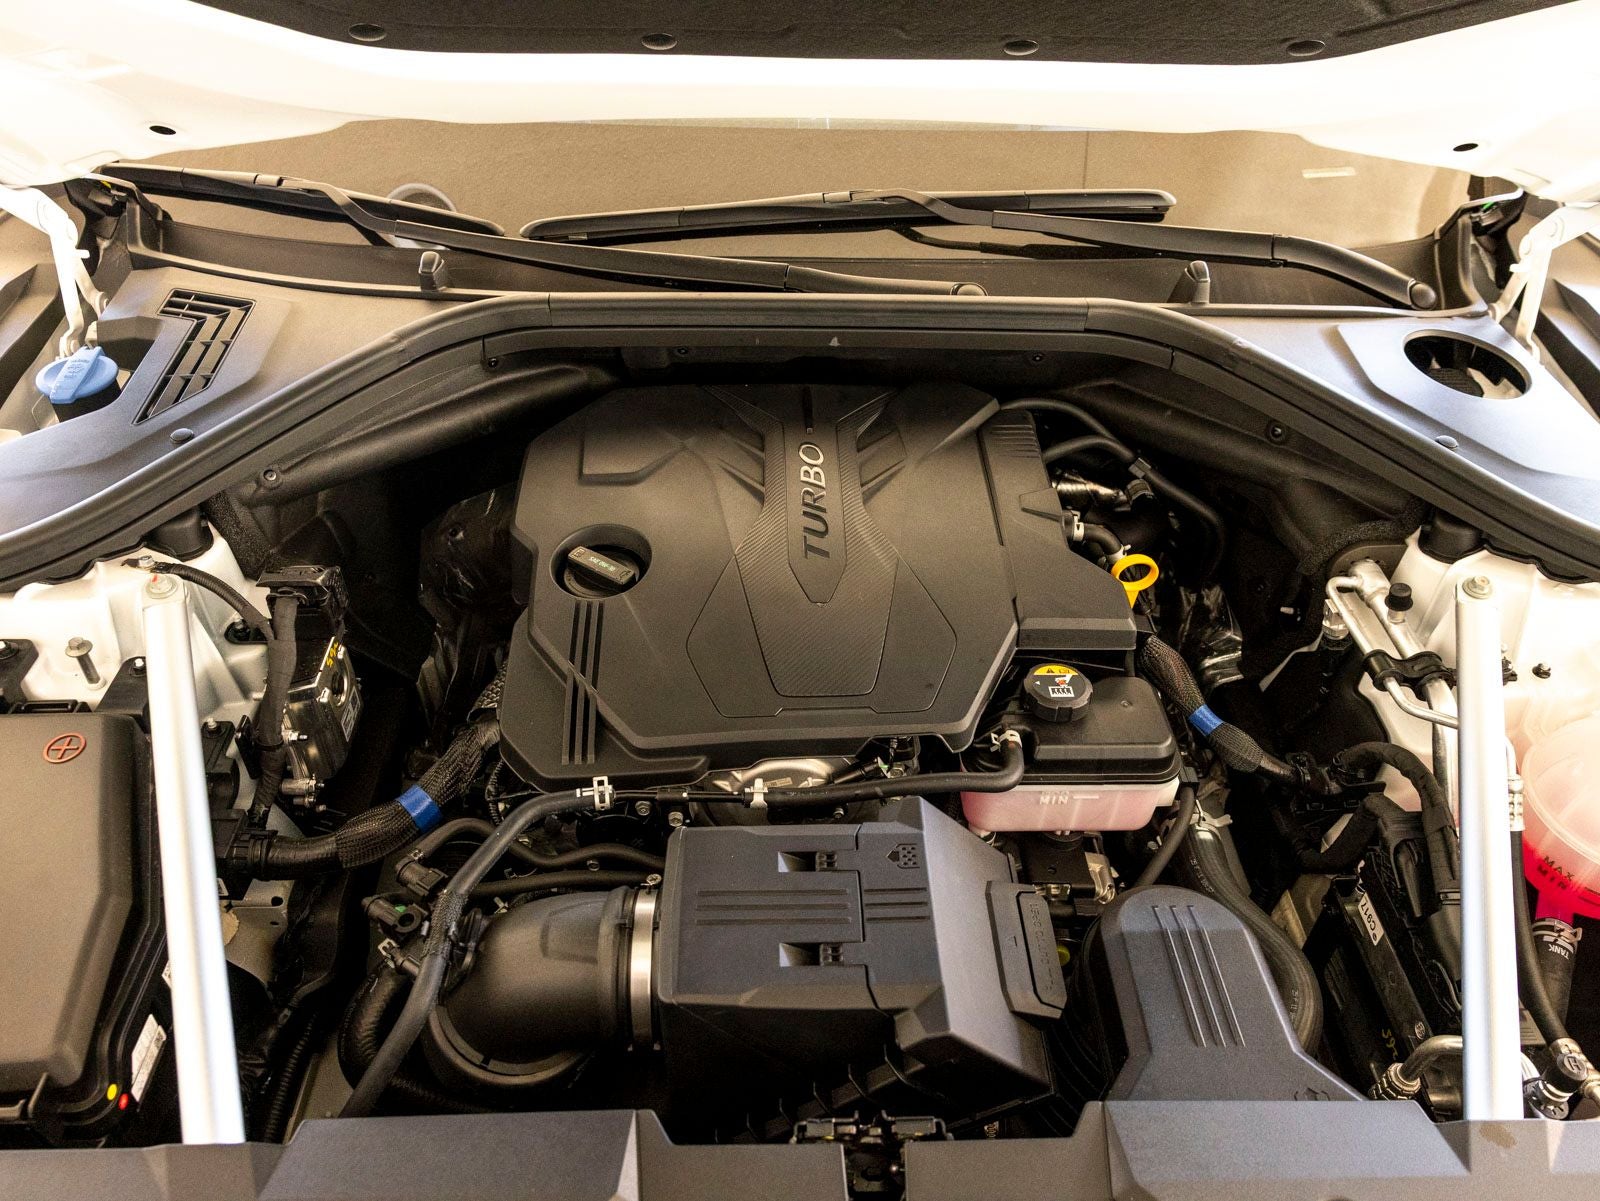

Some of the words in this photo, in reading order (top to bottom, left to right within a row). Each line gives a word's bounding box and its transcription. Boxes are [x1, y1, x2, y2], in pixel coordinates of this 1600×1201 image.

[799, 442, 830, 559] TURBO
[1040, 795, 1069, 805] MIN
[1544, 856, 1575, 881] MAX
[1548, 944, 1569, 960] TANK
